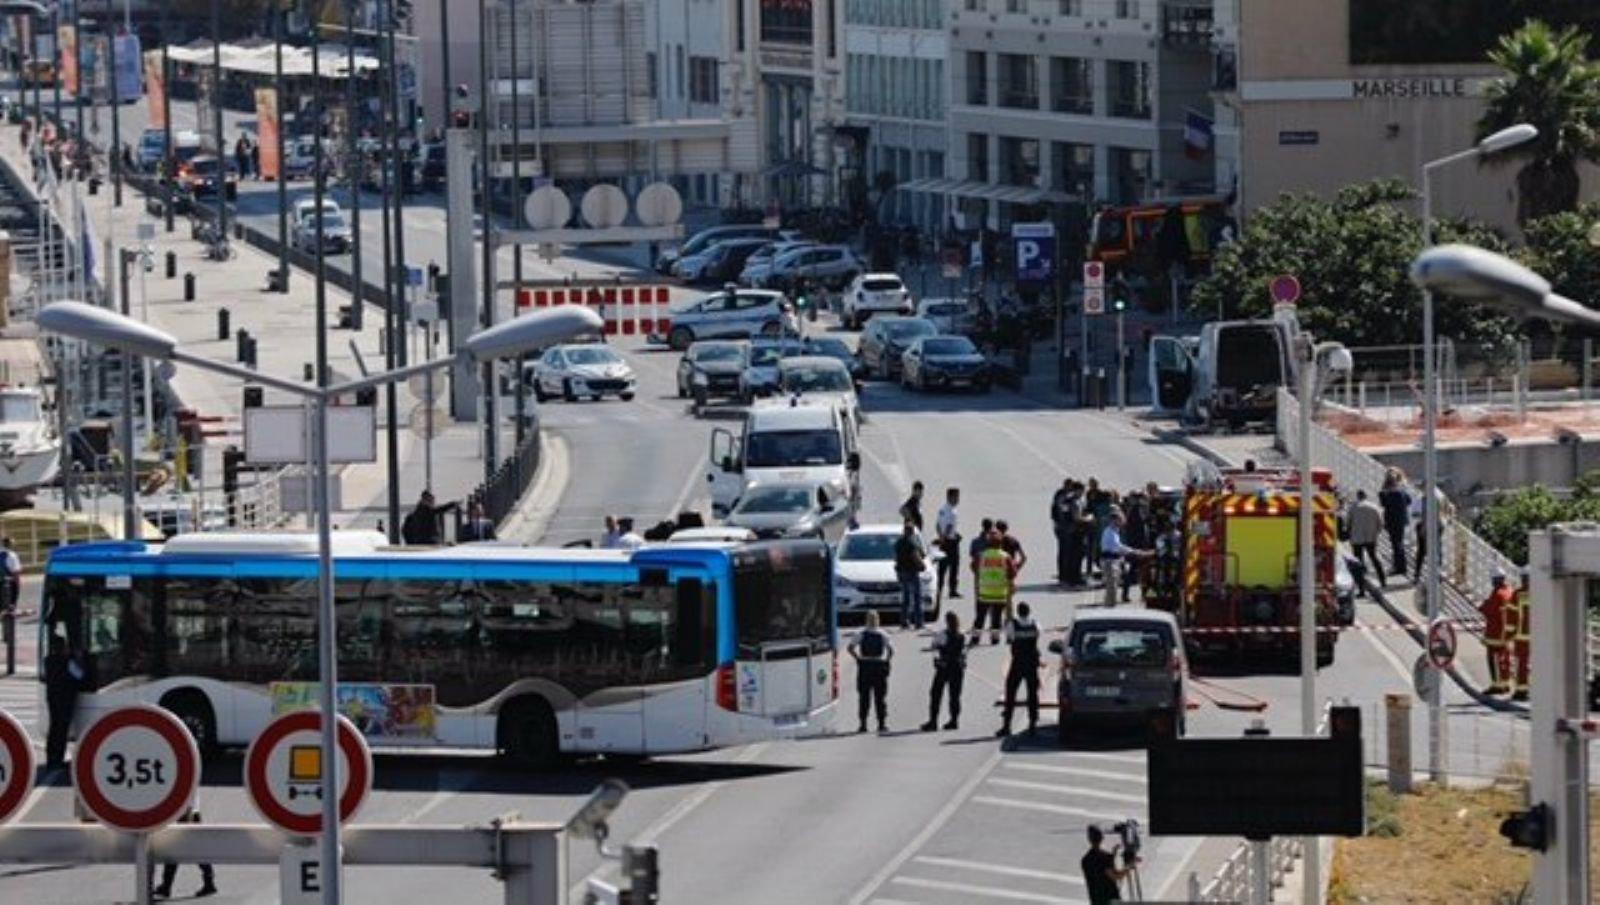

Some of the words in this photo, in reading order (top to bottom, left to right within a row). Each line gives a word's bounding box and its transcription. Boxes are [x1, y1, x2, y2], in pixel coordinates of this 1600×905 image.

[1352, 79, 1465, 97] MARSEILLE
[1017, 240, 1040, 268] P
[106, 752, 165, 789] 3,5t
[301, 861, 321, 892] E
